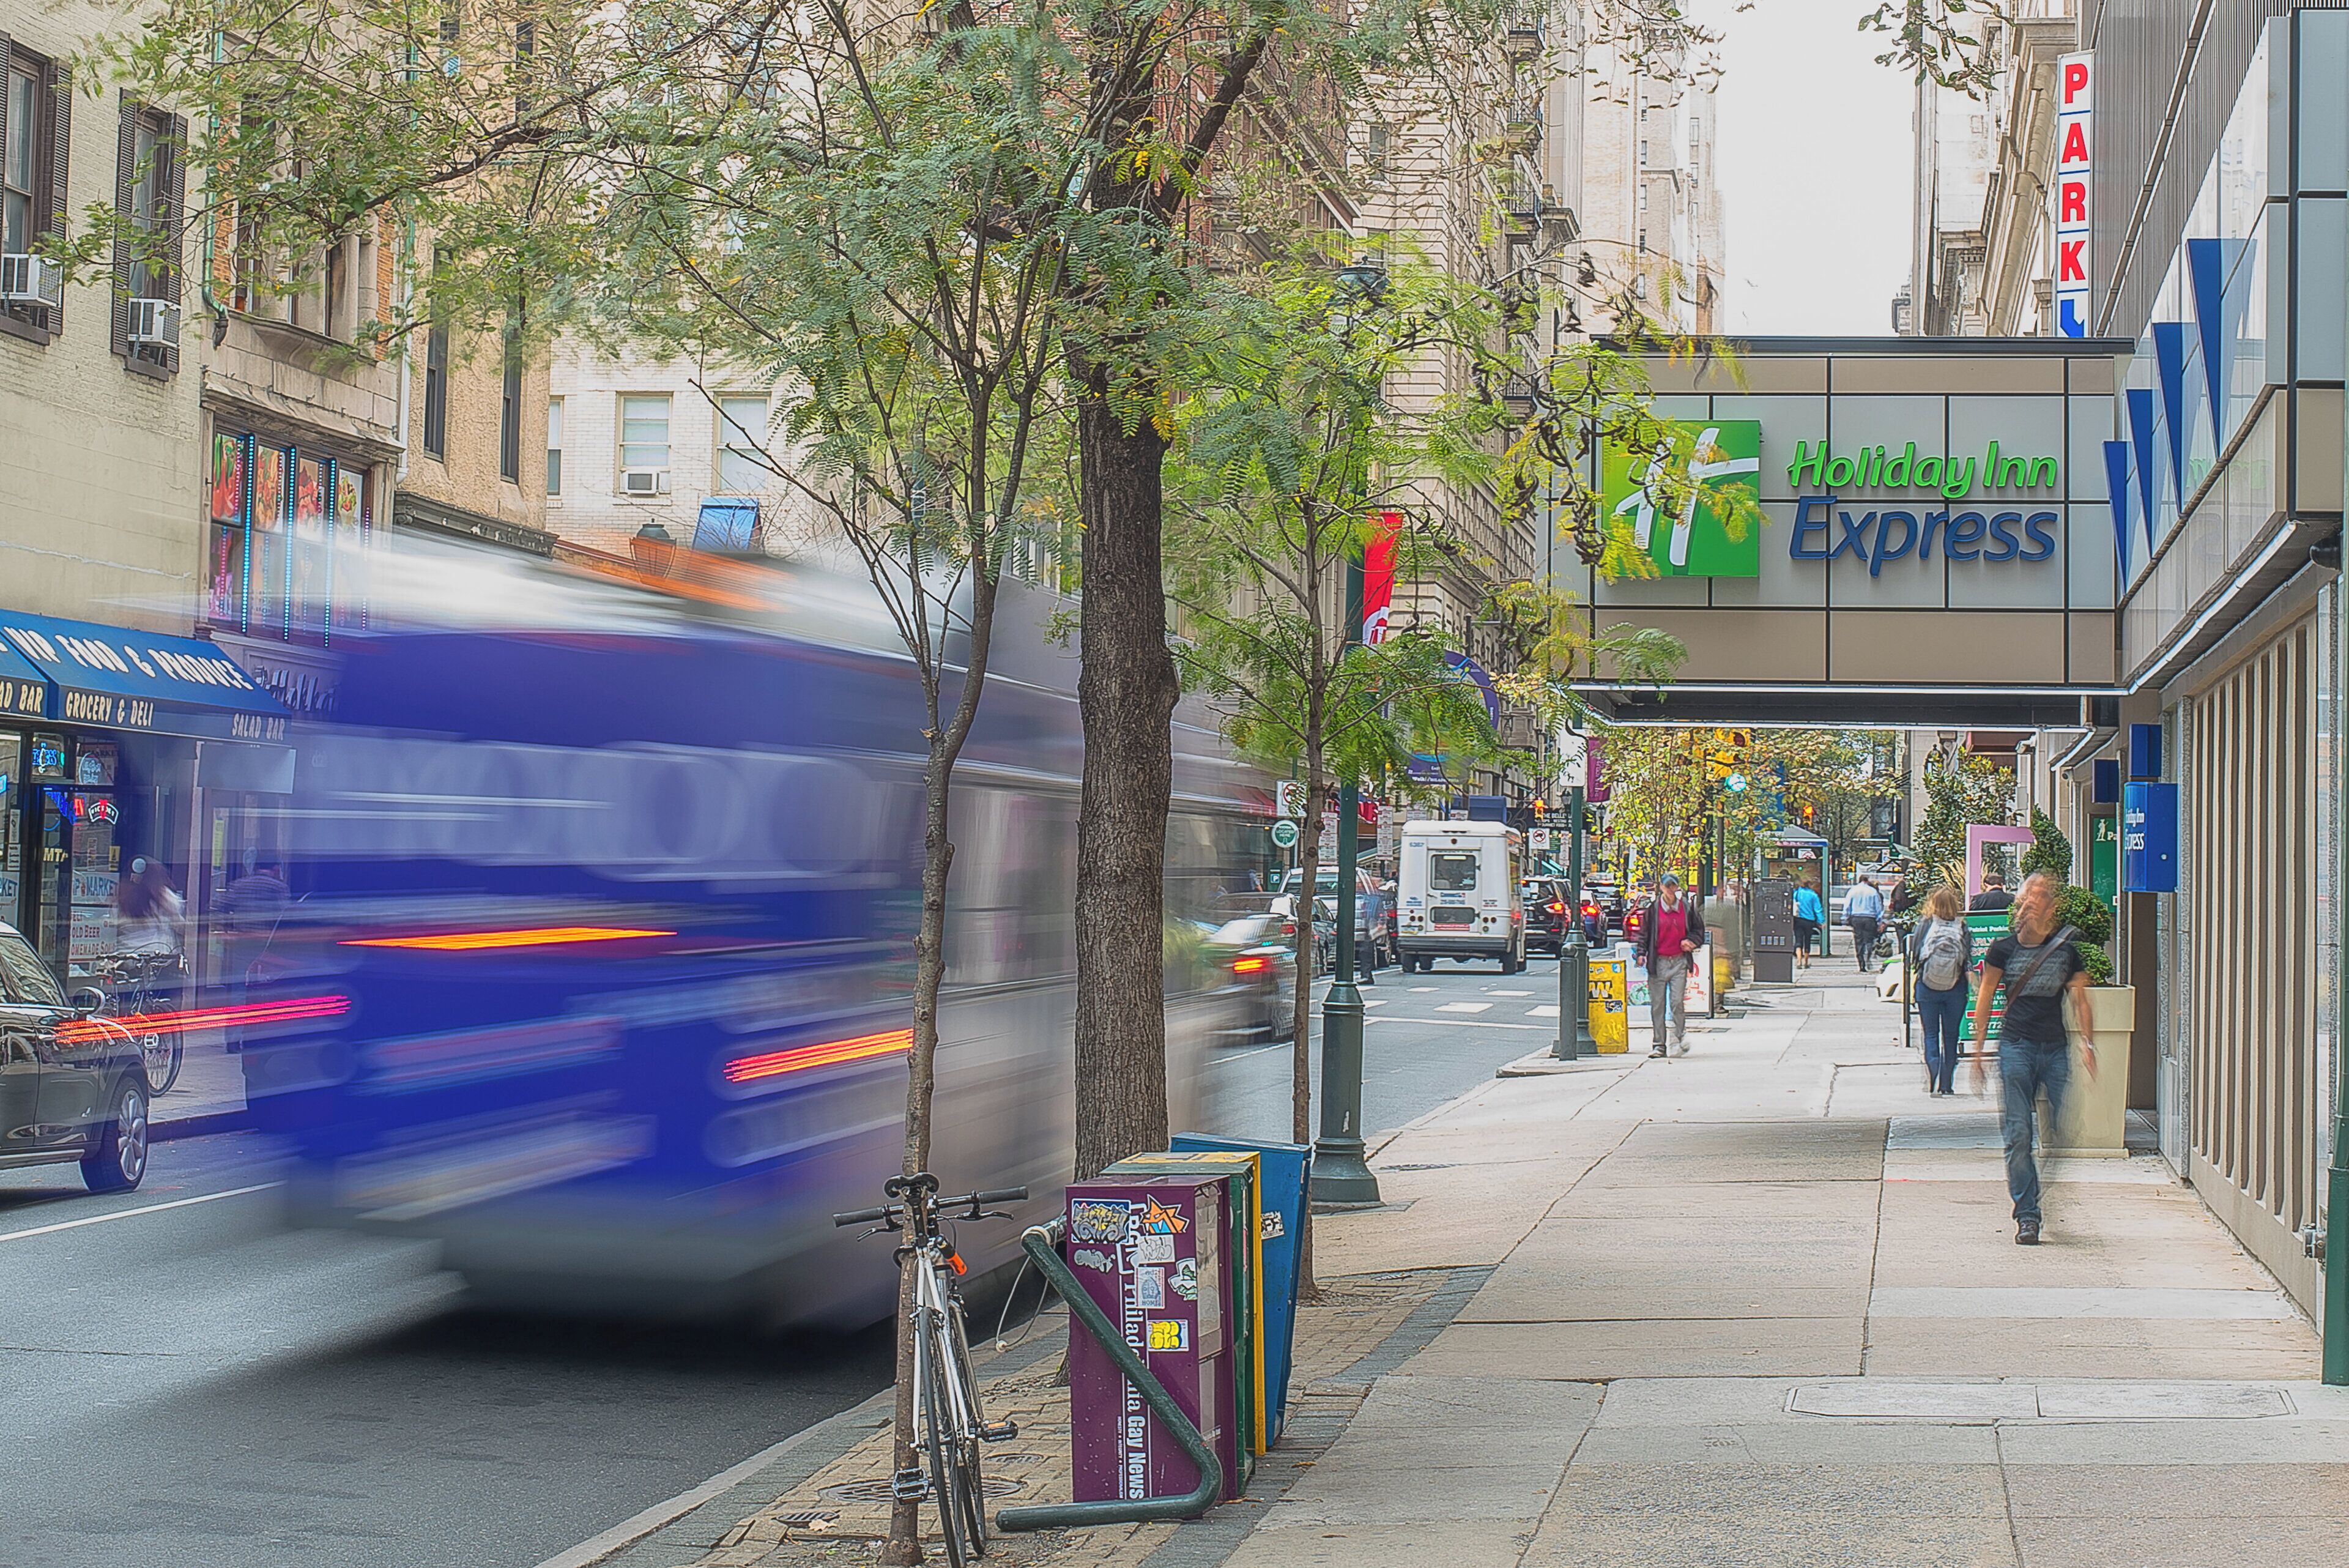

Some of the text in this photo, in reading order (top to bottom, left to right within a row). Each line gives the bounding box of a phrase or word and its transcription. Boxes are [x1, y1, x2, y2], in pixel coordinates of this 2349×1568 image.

[2060, 63, 2088, 282] PARK
[1787, 439, 2057, 498] Holiday Inn
[1790, 495, 2058, 578] Express
[3, 626, 61, 663] VIP
[54, 634, 130, 672] FOOD
[124, 645, 156, 678] &
[147, 648, 254, 691] PRODUCE
[19, 684, 43, 713] BAR
[66, 691, 154, 727] GROCERY & DELI
[232, 713, 286, 741] SALAD BAR
[0, 878, 18, 897] KET
[86, 875, 118, 897] MARKET
[71, 926, 83, 938] OLD
[1126, 1416, 1146, 1449] Gay
[1127, 1452, 1147, 1499] News
